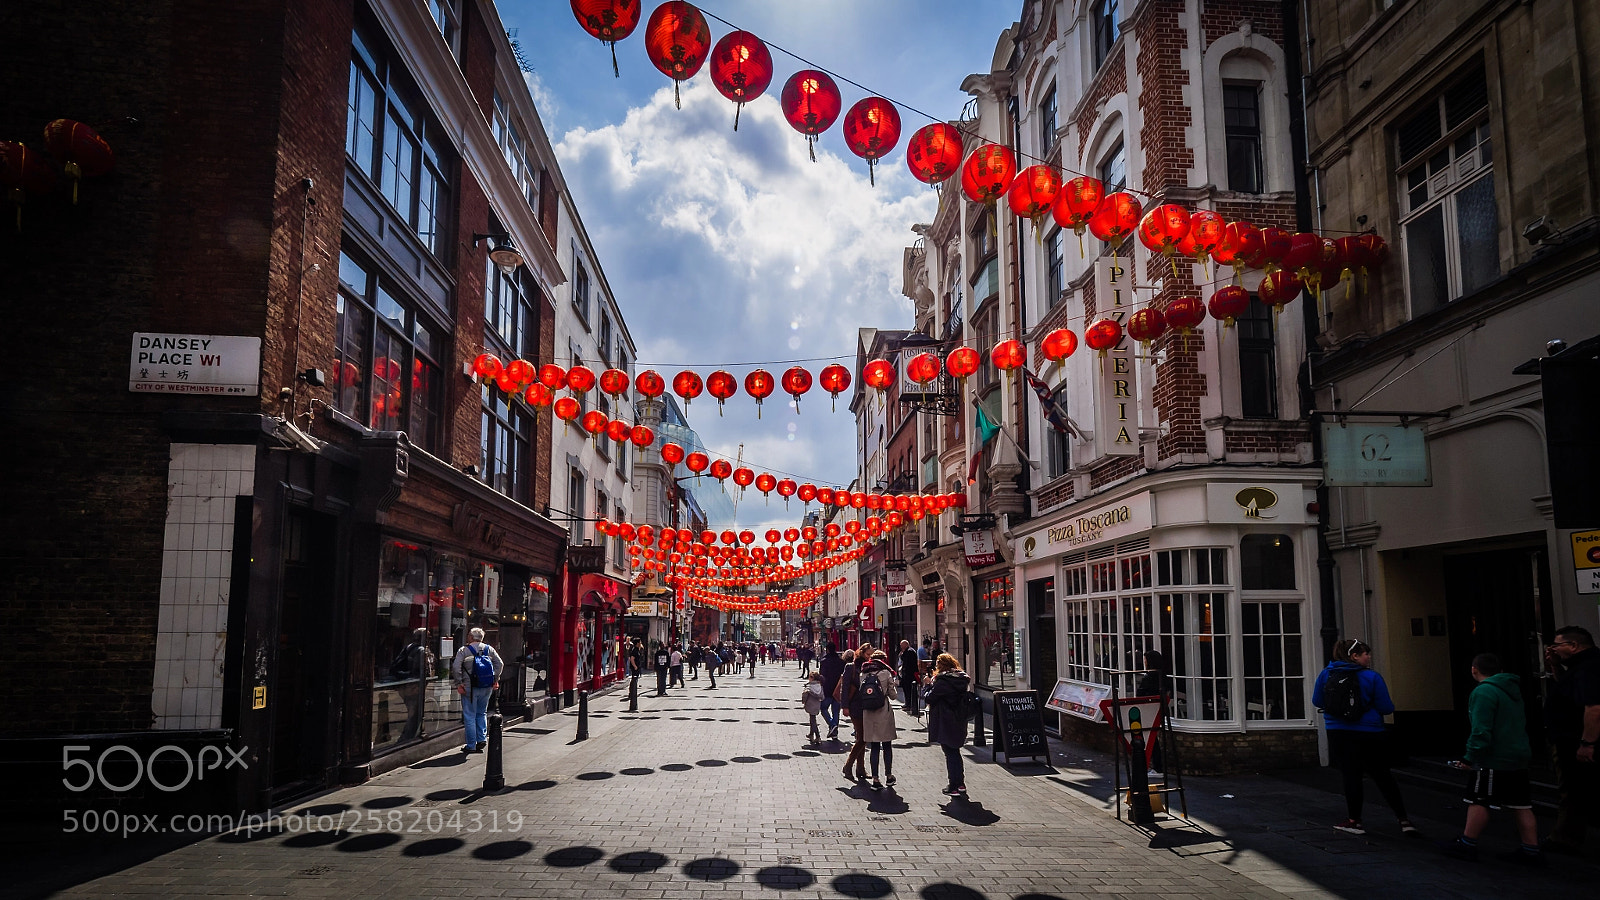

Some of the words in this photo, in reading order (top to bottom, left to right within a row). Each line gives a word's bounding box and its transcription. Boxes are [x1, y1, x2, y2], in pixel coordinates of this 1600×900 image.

[140, 337, 211, 351] DANSEY
[138, 352, 192, 365] PLACE
[200, 354, 221, 366] W1
[1109, 266, 1132, 445] PIZZERIA
[168, 384, 225, 393] WESTMINSTER
[1361, 433, 1392, 461] 62
[1048, 524, 1076, 545] Pizza
[1075, 505, 1131, 535] Toscana
[1068, 530, 1103, 546] TUSCANY
[967, 556, 985, 565] Wong
[986, 555, 996, 563] Kei
